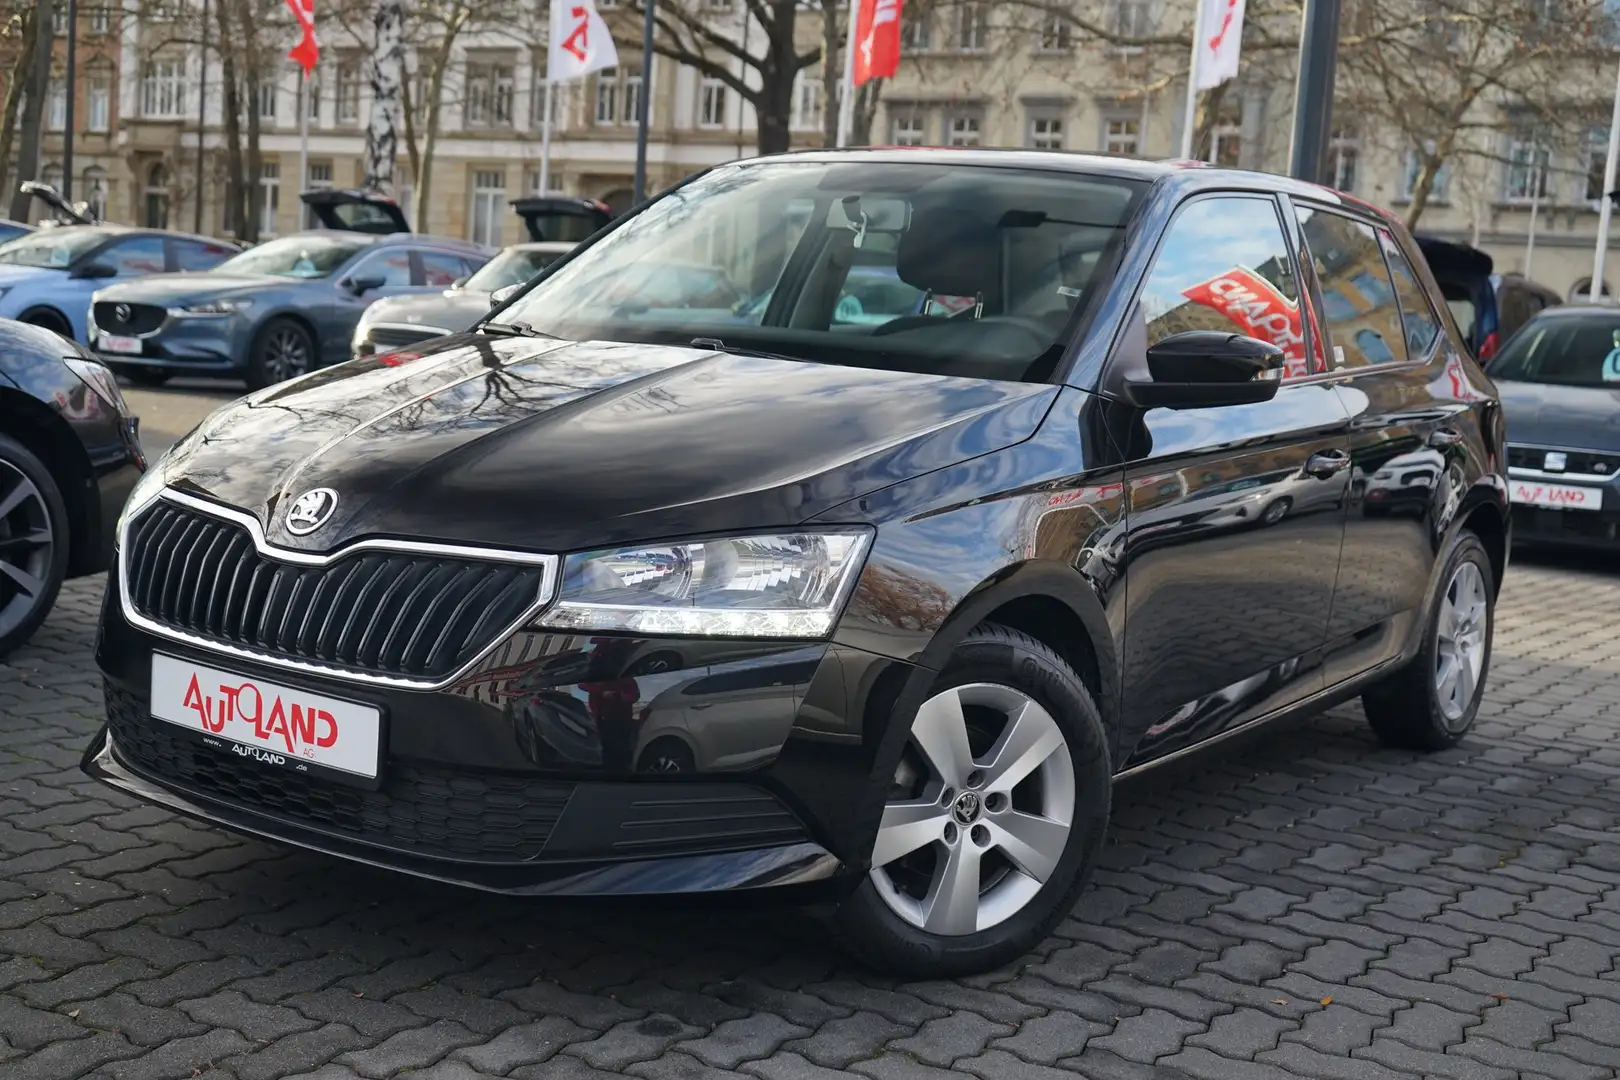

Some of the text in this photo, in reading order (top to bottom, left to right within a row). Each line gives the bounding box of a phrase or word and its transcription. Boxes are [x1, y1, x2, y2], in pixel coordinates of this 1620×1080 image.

[1517, 486, 1585, 504] AUTLAND
[183, 671, 338, 753] AUTOLAND
[231, 743, 286, 765] AUTOLAND
[302, 748, 315, 759] AG
